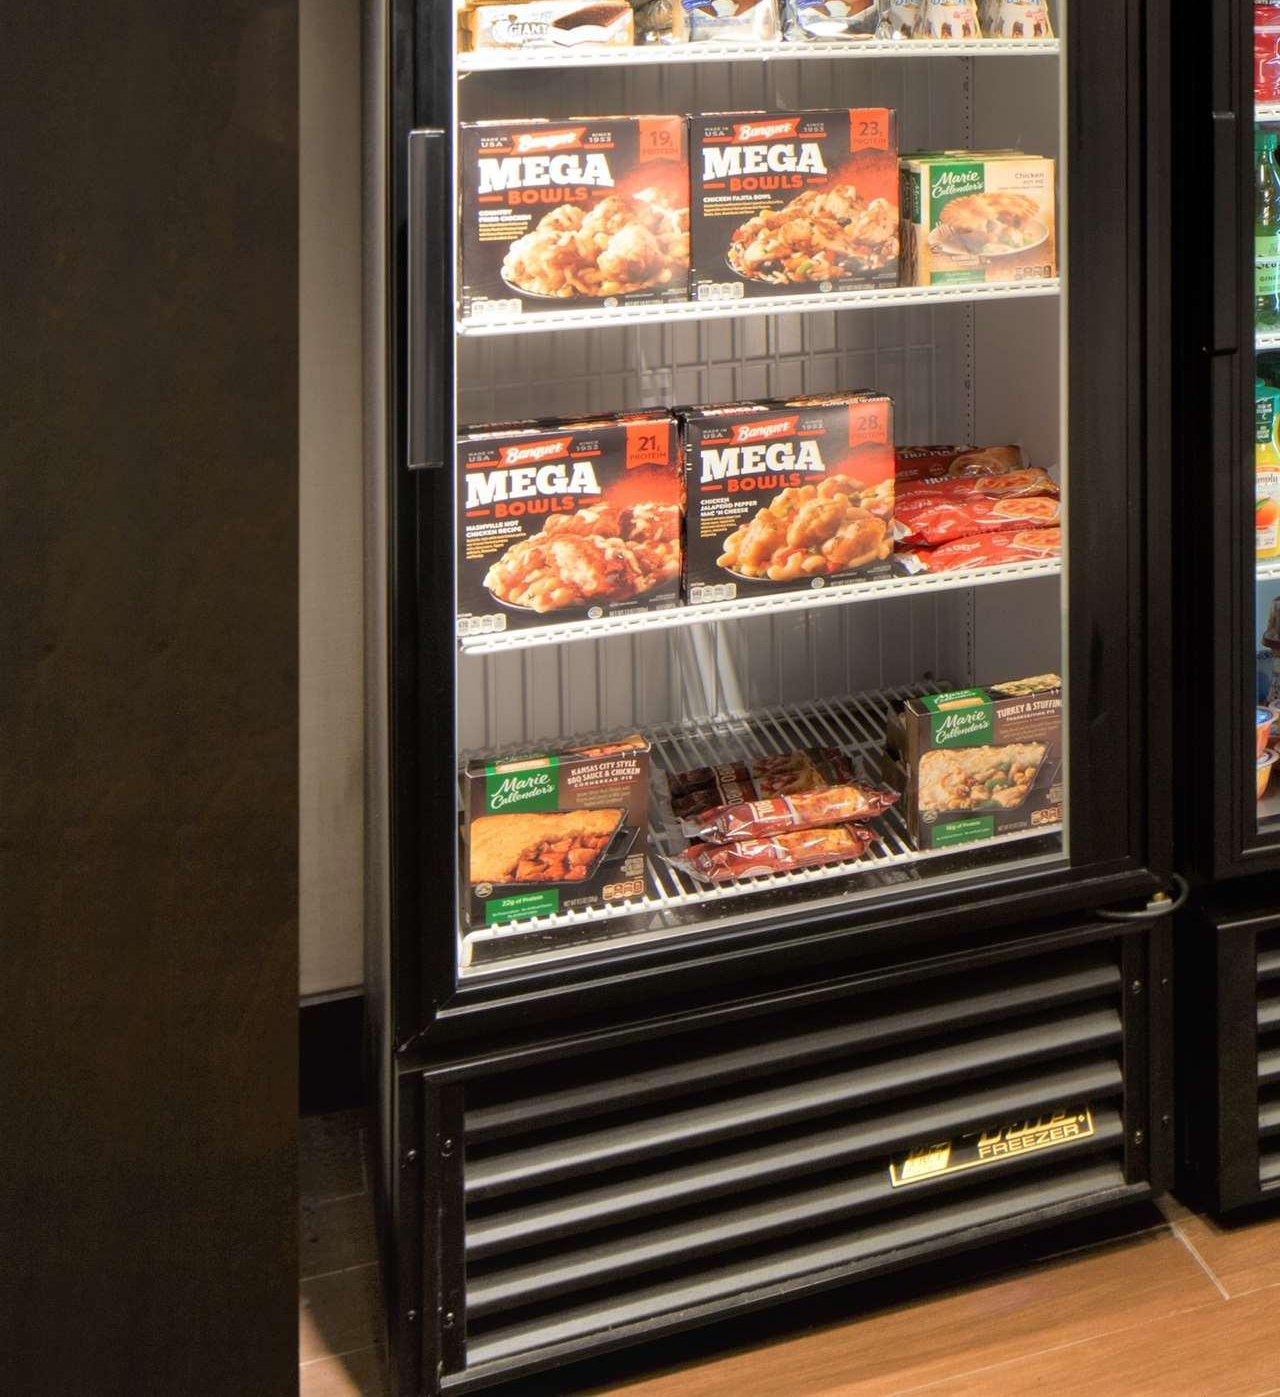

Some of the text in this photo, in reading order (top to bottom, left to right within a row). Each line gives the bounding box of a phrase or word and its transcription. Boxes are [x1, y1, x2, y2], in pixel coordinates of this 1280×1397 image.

[508, 23, 548, 36] GIANT
[738, 122, 792, 141] Banquet
[703, 143, 828, 181] MEGA
[478, 153, 614, 194] MEGA
[730, 175, 803, 191] BOWLS
[932, 170, 981, 189] Marie
[508, 186, 588, 205] BOWLS
[703, 194, 753, 203] CHICKEN FAJITA
[931, 181, 985, 199] Callender's
[736, 421, 791, 442] Banquet
[506, 443, 564, 463] Banquet
[630, 452, 667, 460] PROTEIN
[700, 440, 825, 484] MEGA
[466, 461, 601, 509] MEGA
[727, 473, 800, 493] BOWLS
[495, 497, 575, 517] BOWLS
[700, 497, 730, 505] CHICKEN
[724, 506, 749, 514] CHEESE
[466, 521, 503, 532] NASHVILLE
[466, 526, 523, 538] CHICKEN RECIPE
[936, 709, 986, 733] Marie
[996, 705, 1026, 719] TURKEY
[935, 721, 991, 744] Callender's
[567, 767, 641, 785] BBQ SAUCE CHICKEN
[570, 759, 638, 776] KANSAS CITY STYLE
[491, 773, 551, 798] Marie
[490, 786, 555, 810] Callender's
[978, 1122, 1080, 1160] FREEZER
